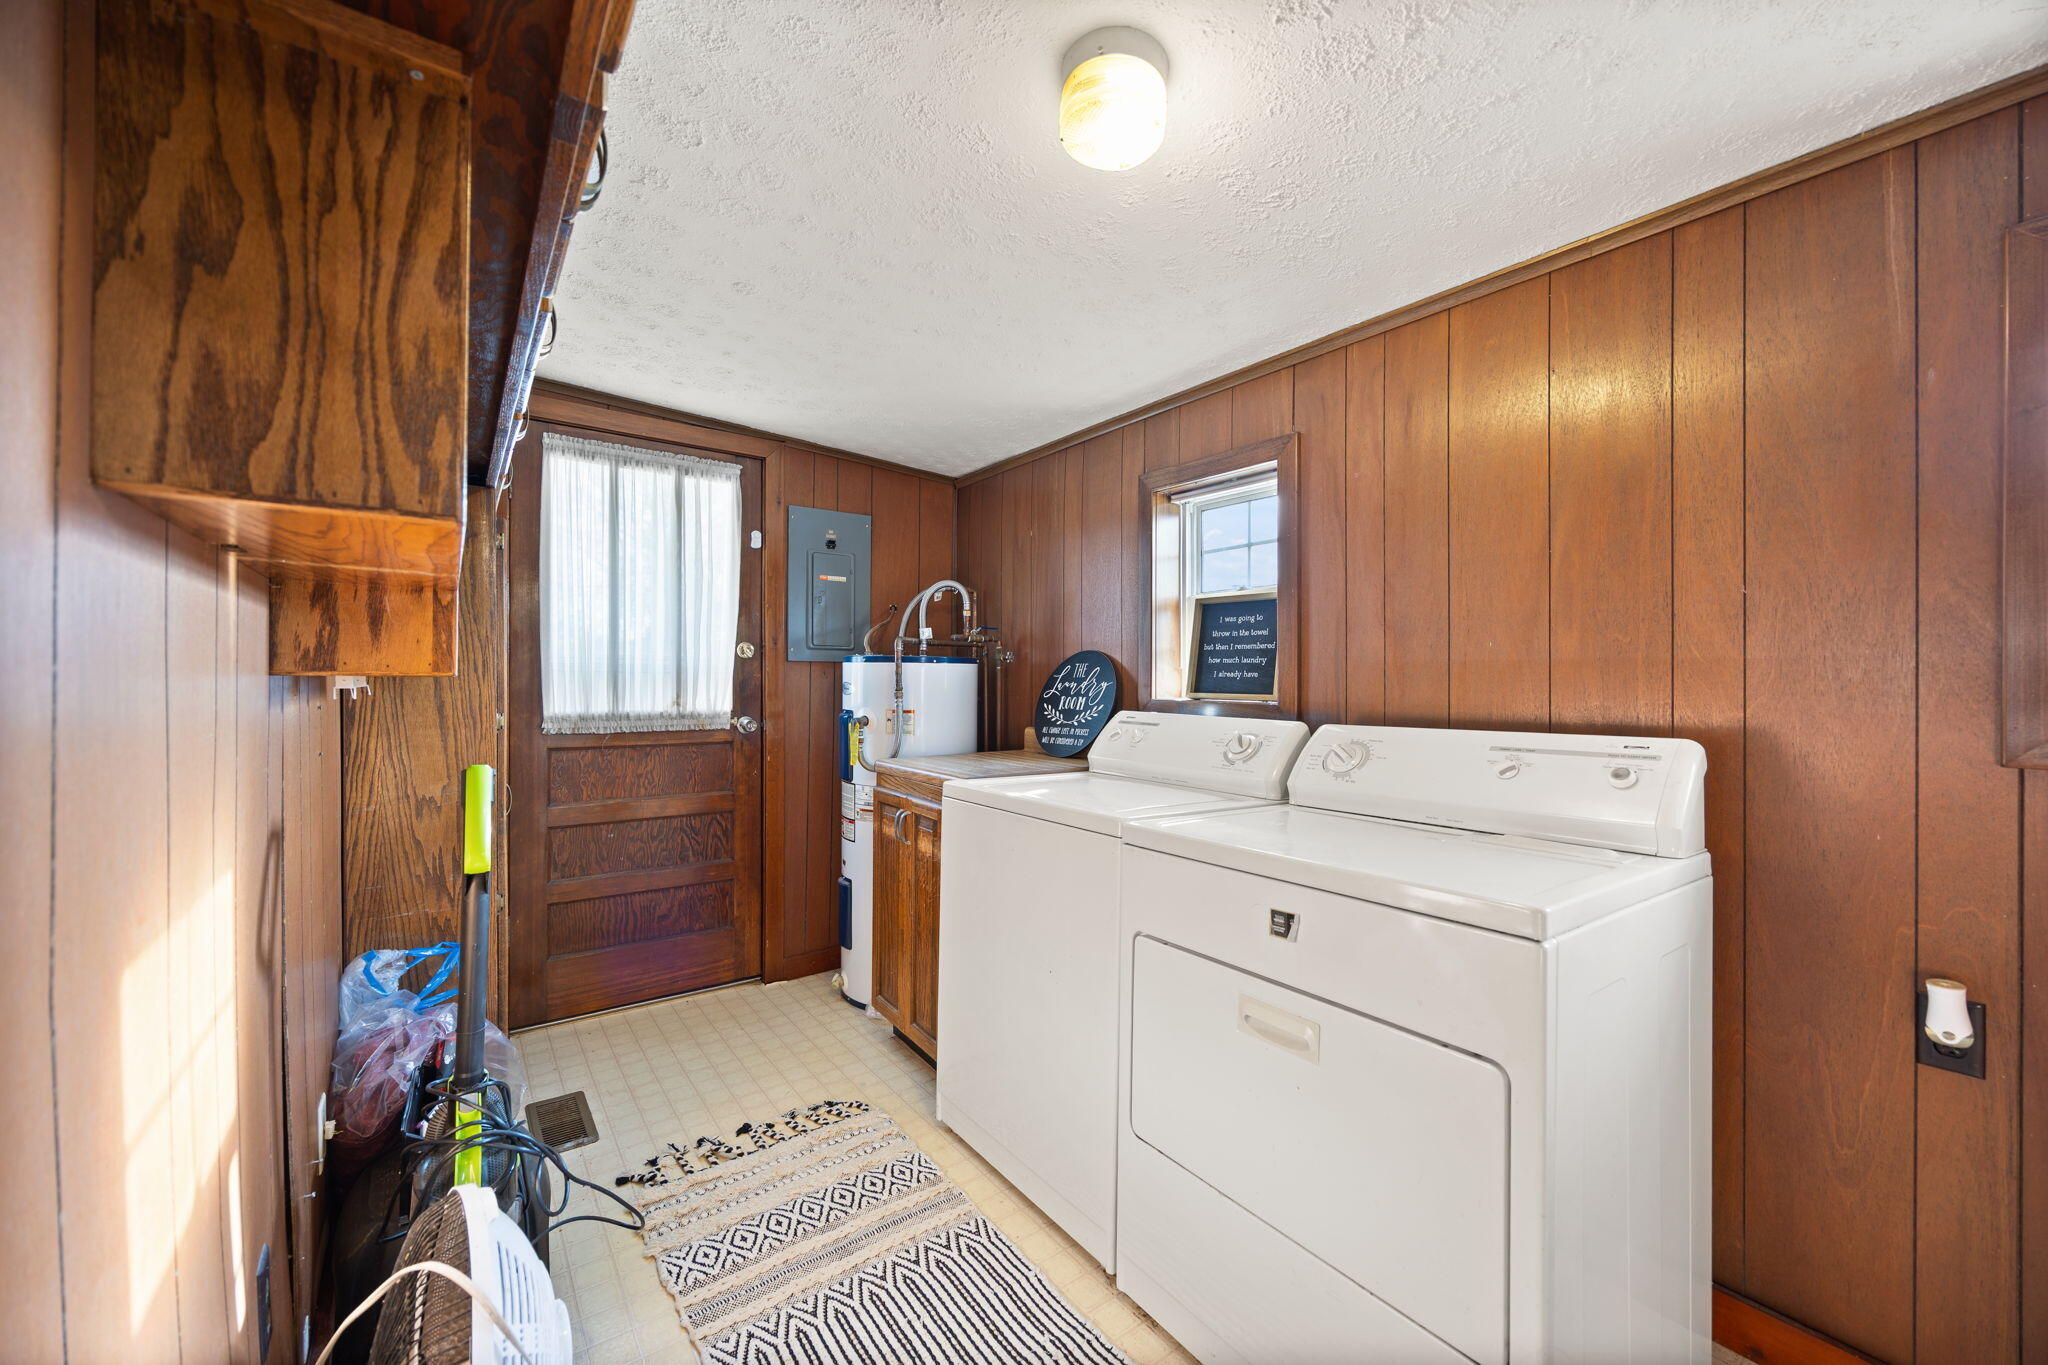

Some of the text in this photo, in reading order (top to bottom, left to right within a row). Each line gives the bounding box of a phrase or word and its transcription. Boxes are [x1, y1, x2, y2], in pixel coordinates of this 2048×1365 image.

[1238, 615, 1255, 623] going
[1251, 628, 1269, 636] towel
[1241, 656, 1267, 665] laundry
[1073, 662, 1089, 678] THE
[1219, 671, 1241, 679] already
[1043, 665, 1113, 706] Laundry
[1058, 696, 1087, 710] ROOM
